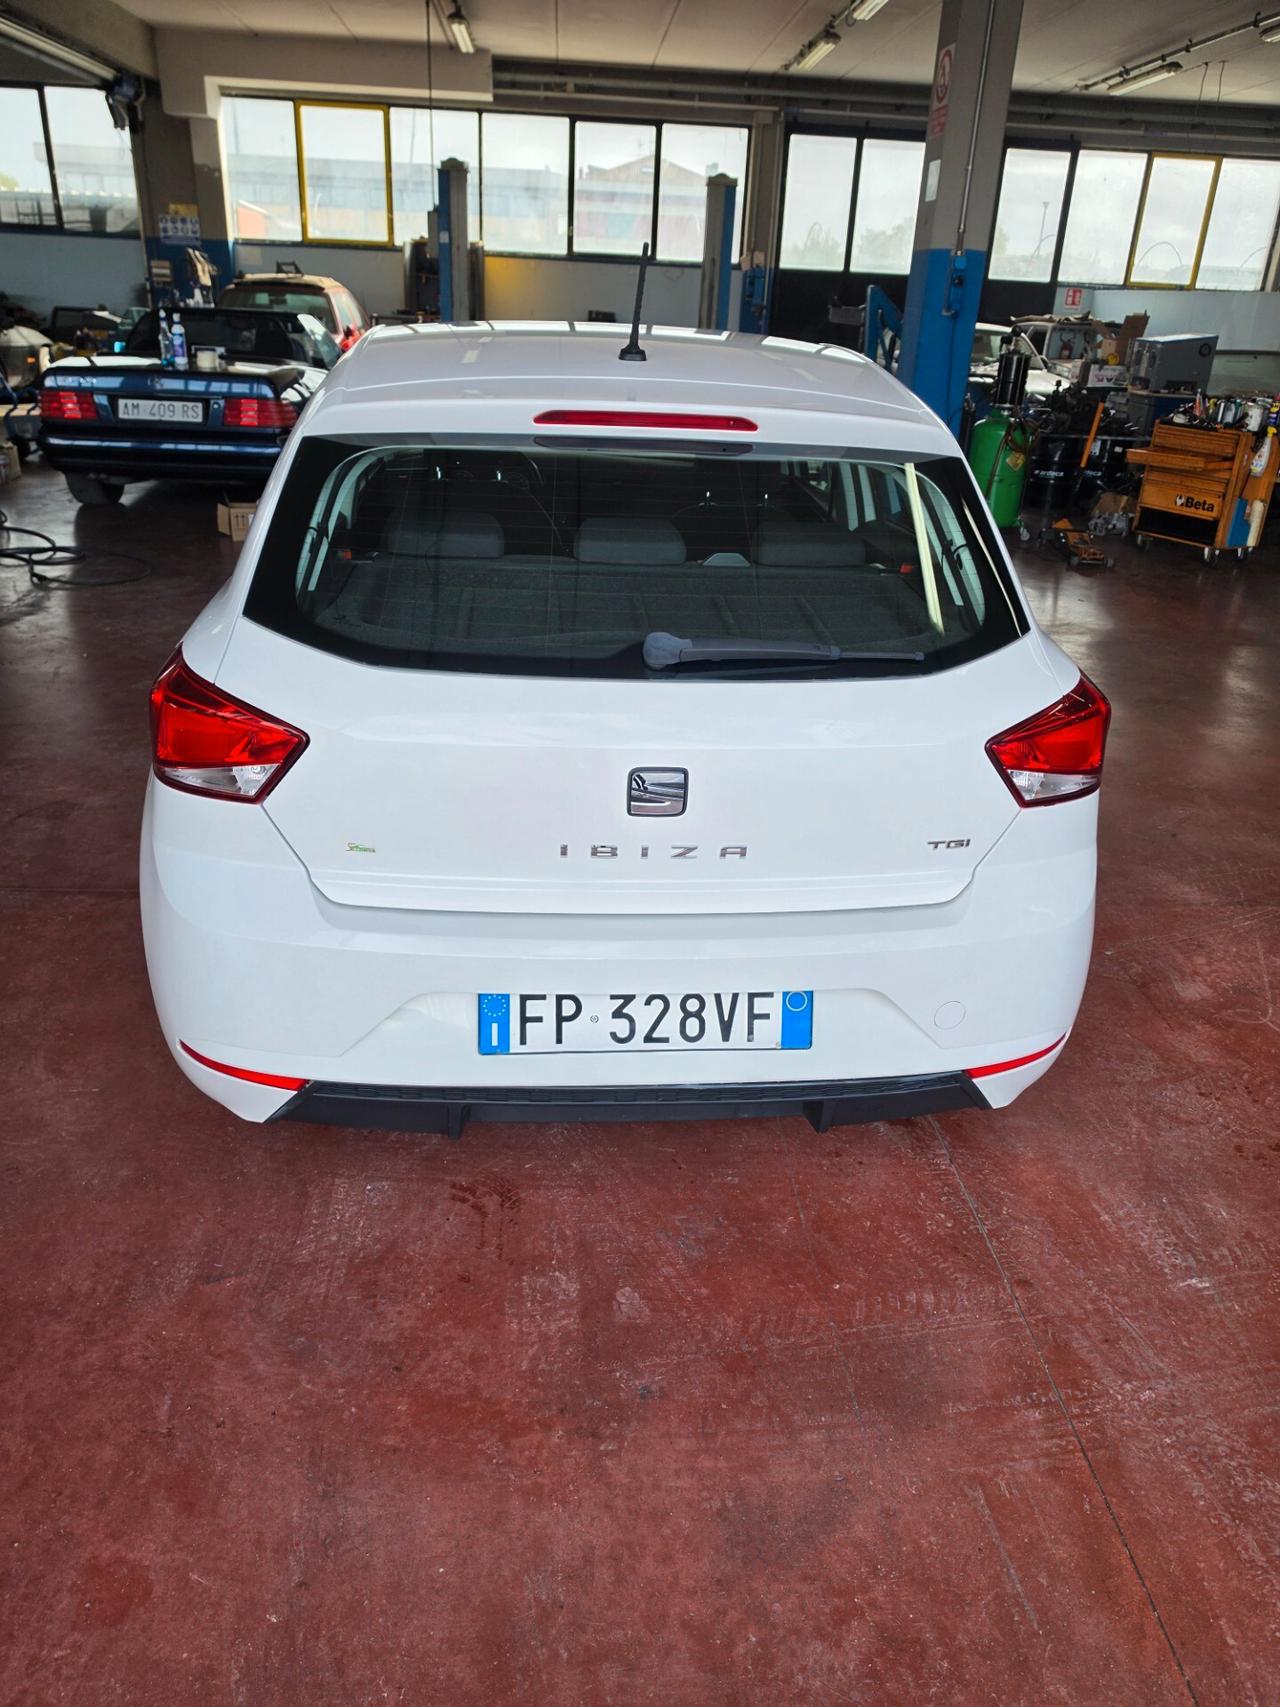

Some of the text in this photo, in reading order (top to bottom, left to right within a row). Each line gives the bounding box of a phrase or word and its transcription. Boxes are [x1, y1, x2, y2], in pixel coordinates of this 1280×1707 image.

[122, 401, 200, 420] AM 409 RS
[1185, 496, 1215, 512] Beta
[560, 844, 748, 858] IBIZA
[927, 839, 971, 849] TGI
[519, 994, 583, 1046] FP
[609, 992, 775, 1044] 328VF
